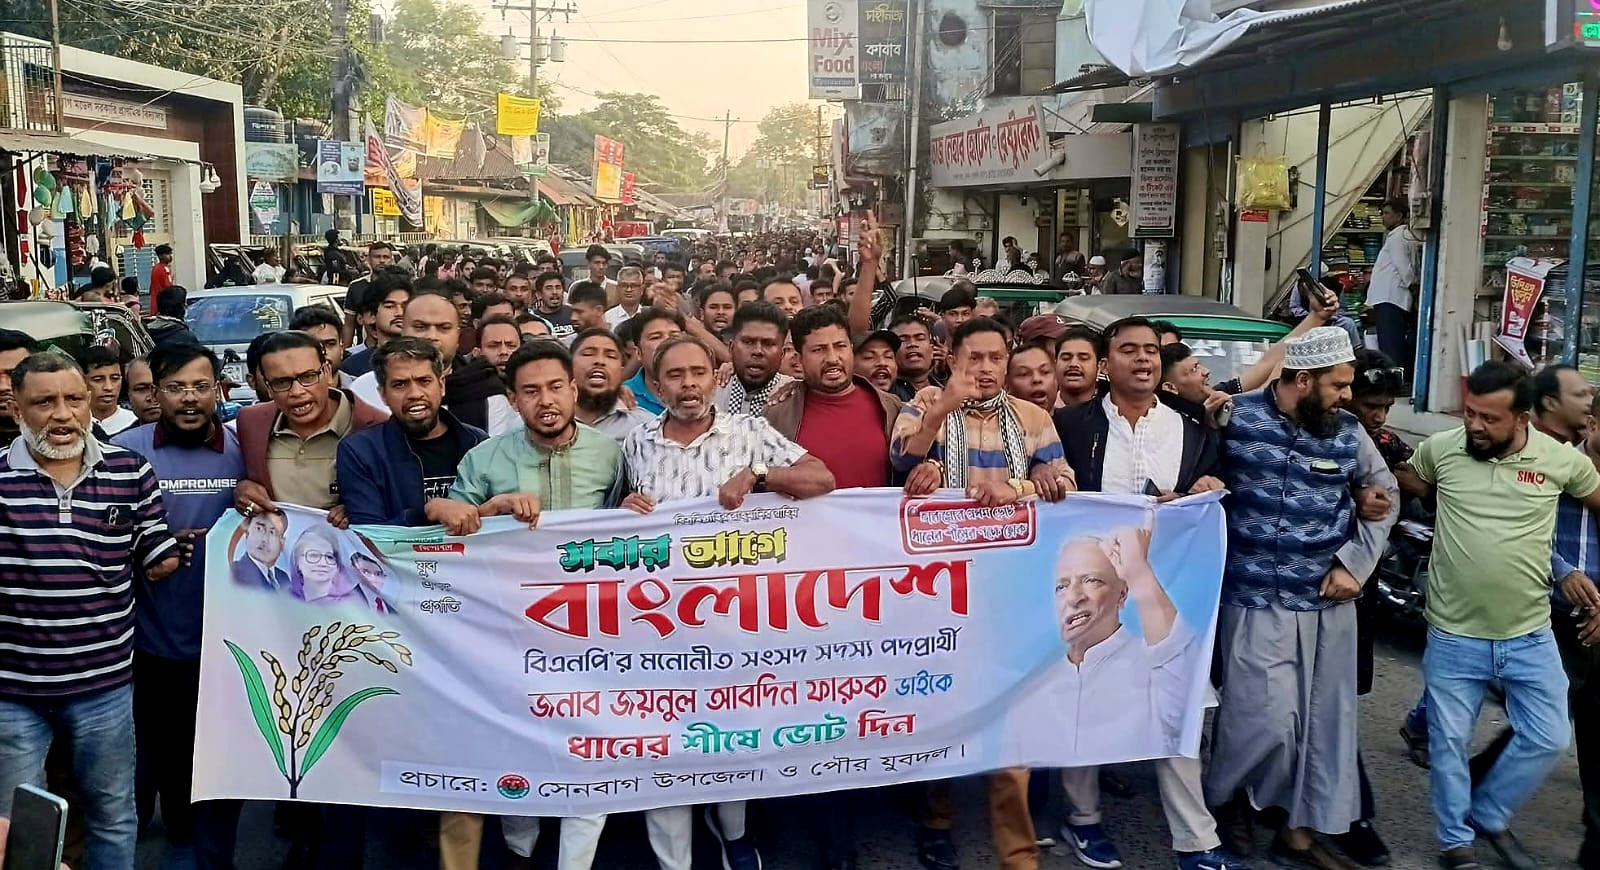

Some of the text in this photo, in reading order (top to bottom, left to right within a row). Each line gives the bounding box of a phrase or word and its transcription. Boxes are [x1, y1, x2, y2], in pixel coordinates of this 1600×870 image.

[813, 27, 854, 56] Mix
[864, 42, 902, 57] কাবাব
[814, 55, 854, 73] Food
[158, 478, 237, 489] OMPROMISE
[556, 527, 787, 573] সবার আগে
[911, 529, 944, 545] ধানের
[415, 560, 438, 577] যুব
[420, 596, 462, 614] প্রগতি
[520, 558, 973, 638] বাংলাদেশ
[640, 646, 734, 672] মনোনীত
[741, 646, 808, 668] সংসদ
[815, 640, 874, 662] সদস্য
[881, 627, 963, 657] পদপ্রার্থী
[528, 670, 953, 723] জনাব জয়নুল আবদিন ফারুক ভাইকে
[567, 710, 917, 760] ধানের শীষে ভোট দিন
[538, 775, 643, 799] সেনবাগ
[652, 767, 764, 788] উপজেলা
[778, 765, 798, 778] ও
[811, 755, 871, 777] পৌর
[880, 745, 953, 772] যুবদল
